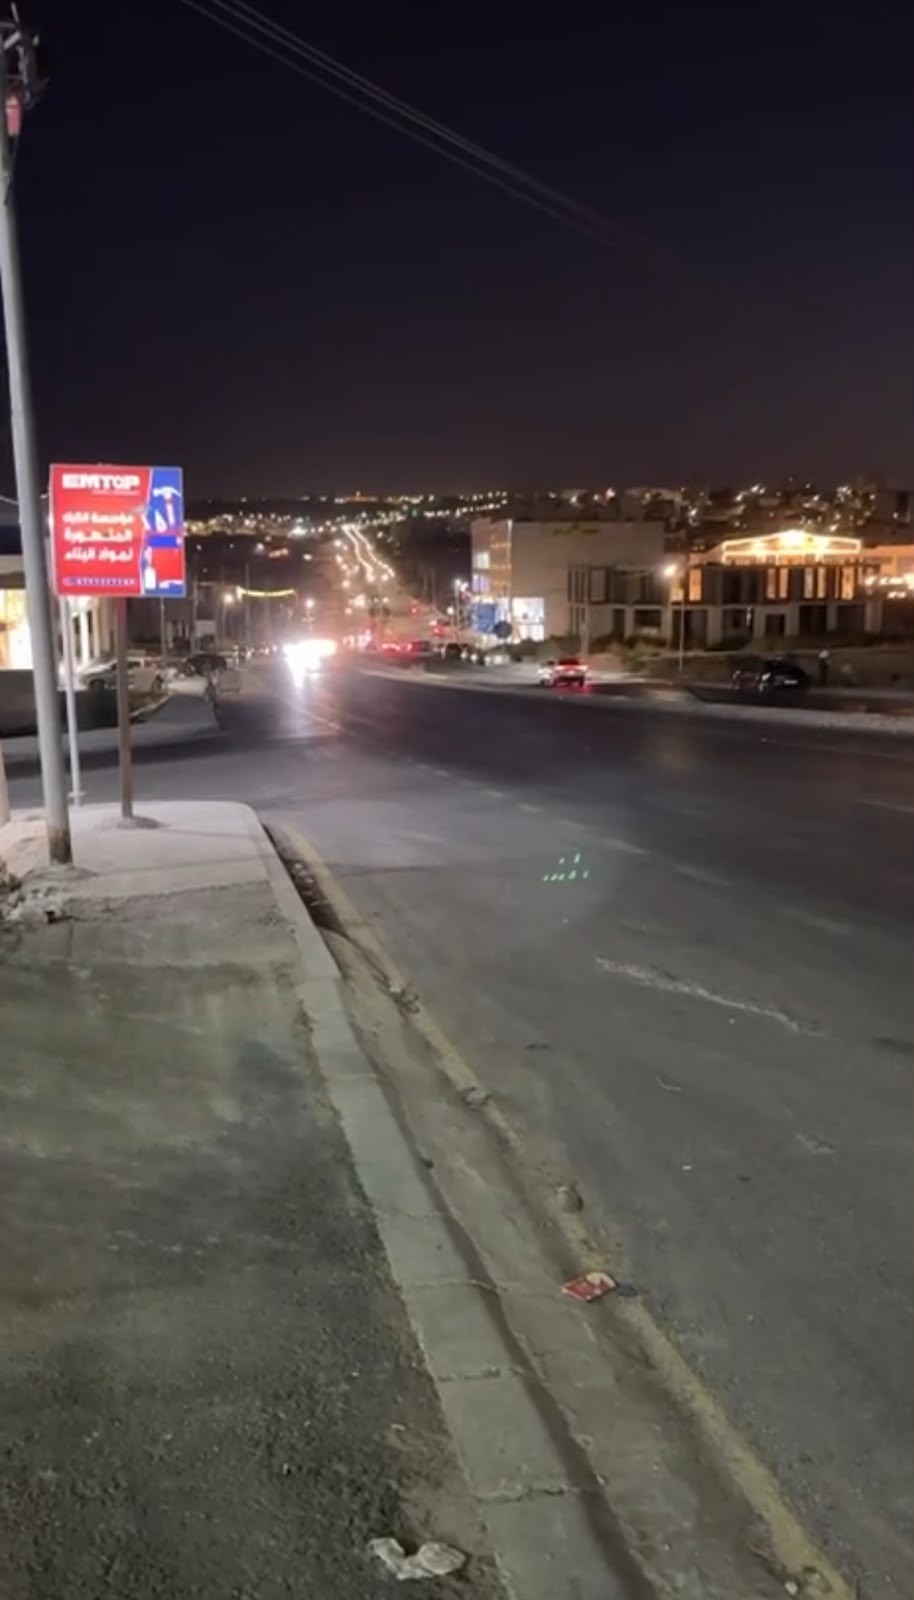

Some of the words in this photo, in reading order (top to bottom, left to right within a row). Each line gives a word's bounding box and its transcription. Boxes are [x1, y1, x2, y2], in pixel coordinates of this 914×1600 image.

[62, 473, 140, 490] EMTOP
[92, 512, 134, 526] مؤسسة
[65, 547, 95, 563] البناء
[98, 547, 133, 562] لمواد
